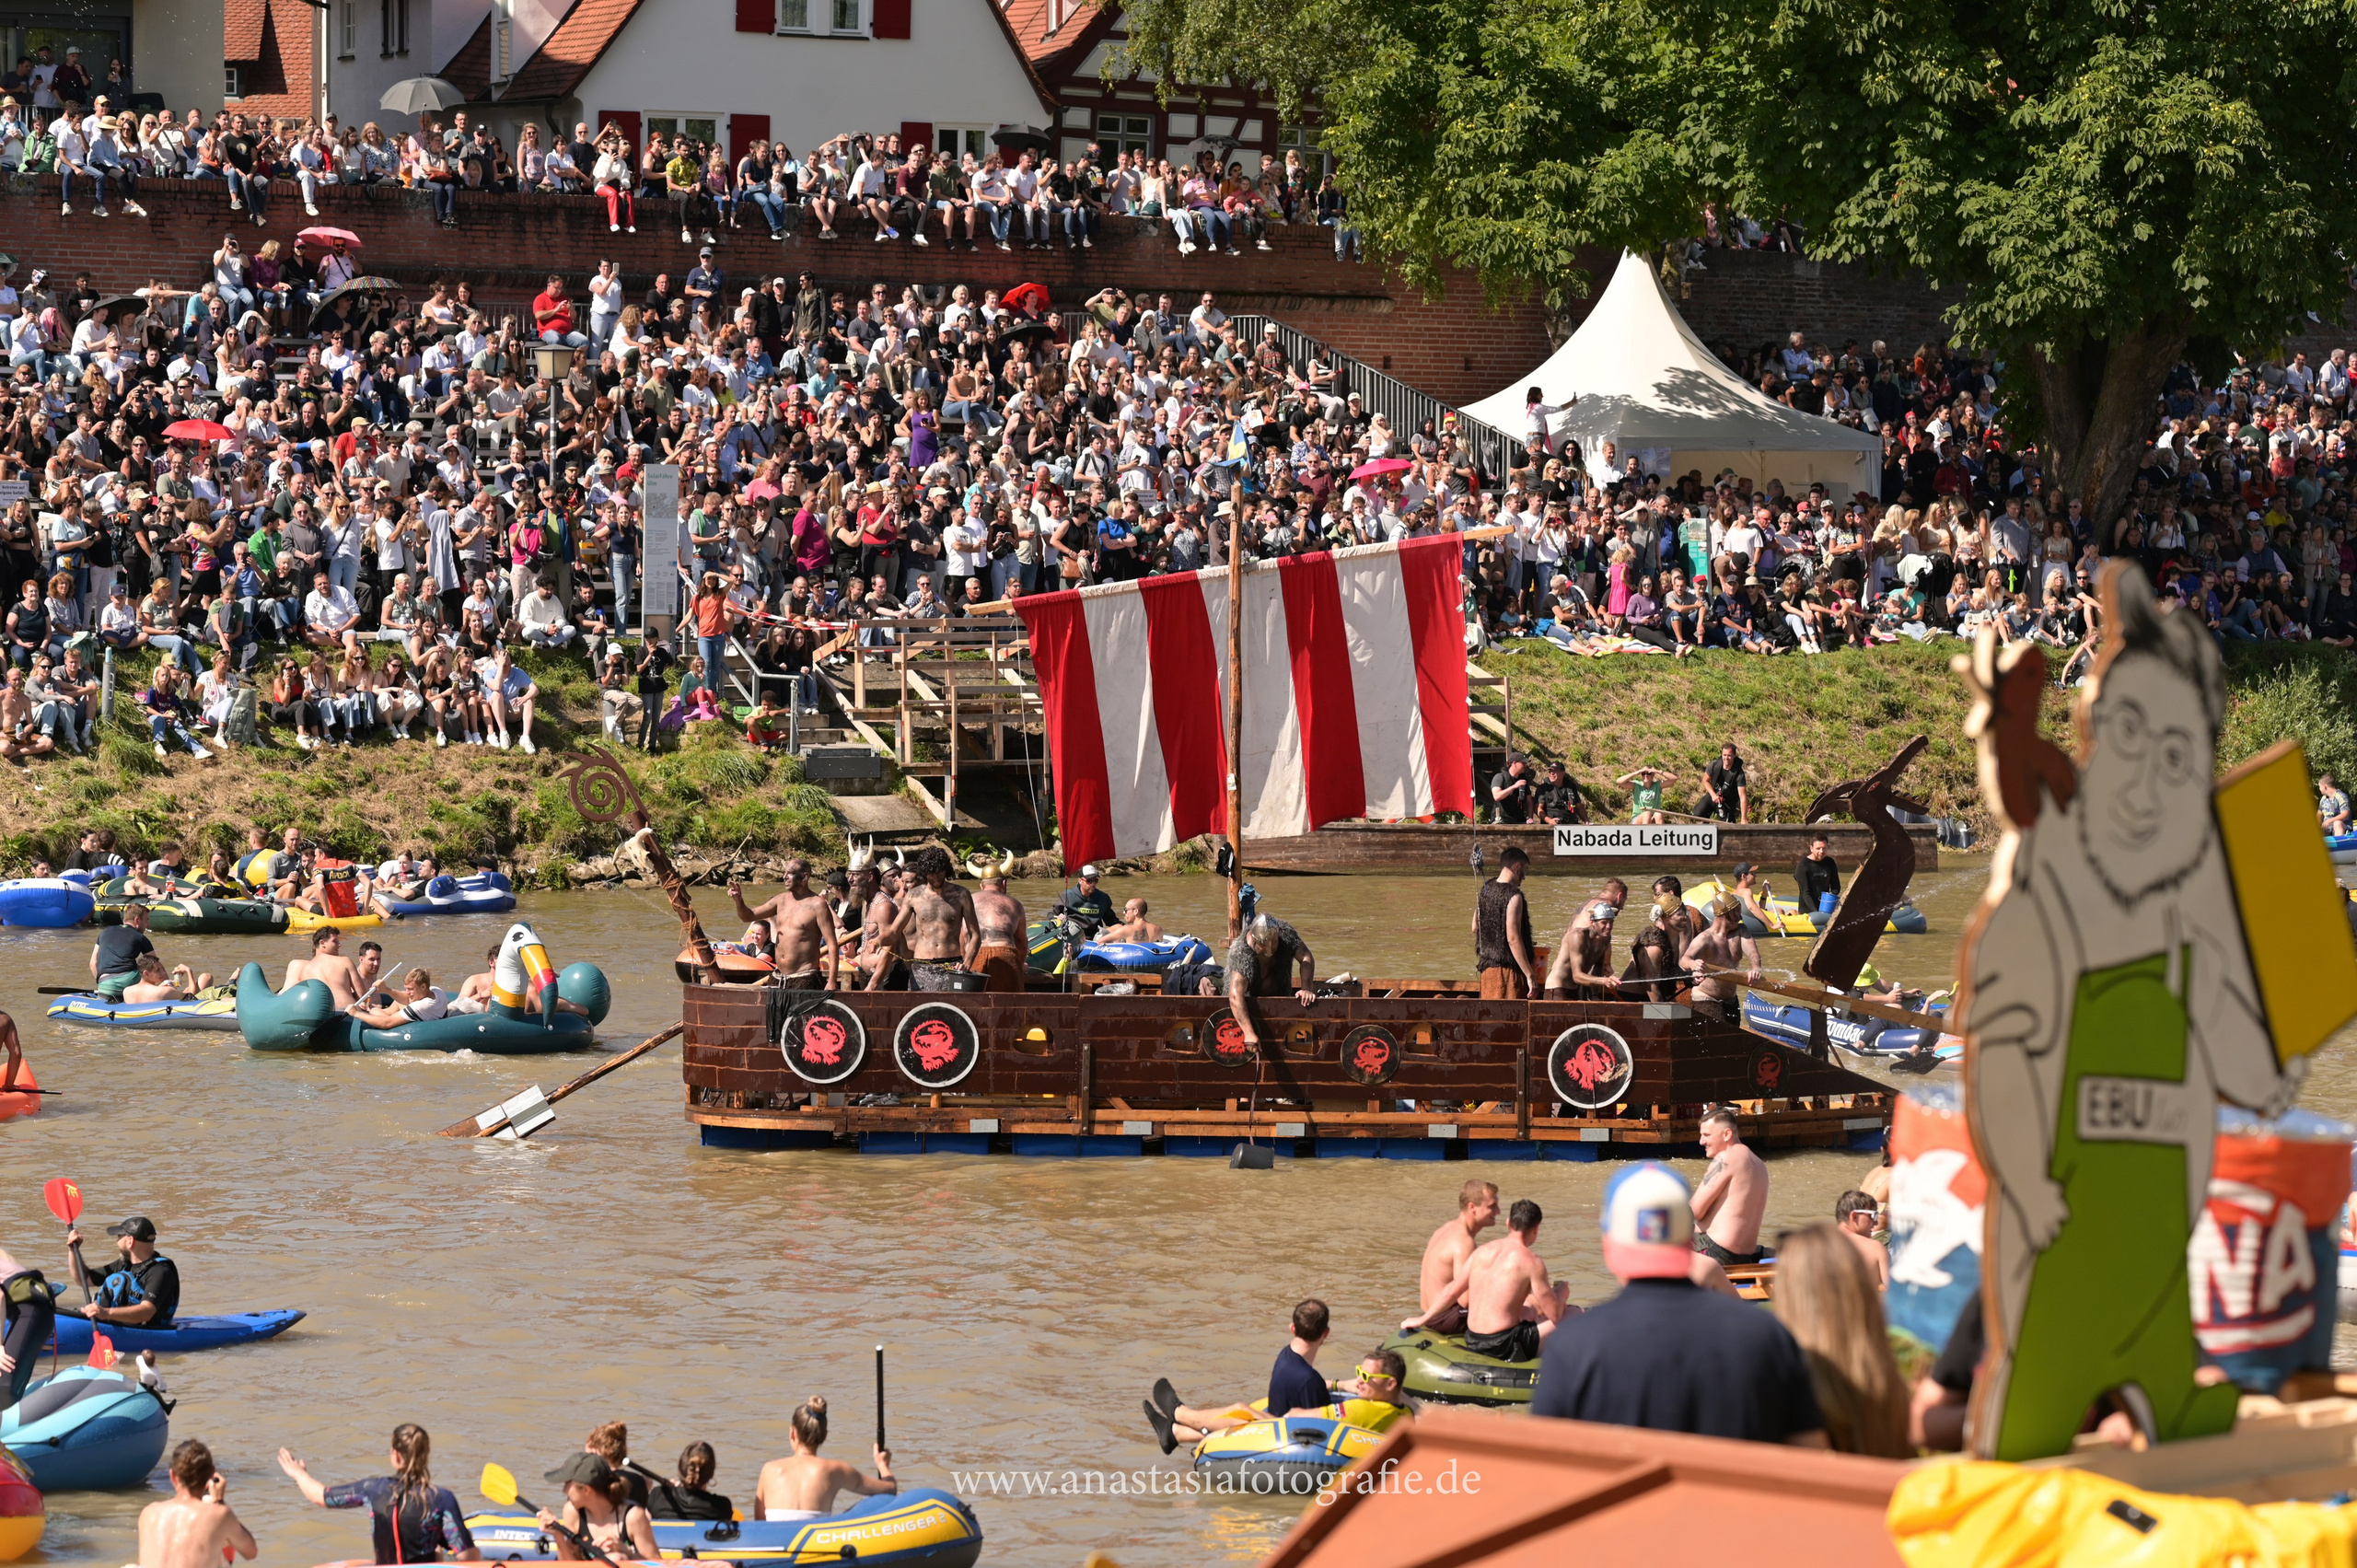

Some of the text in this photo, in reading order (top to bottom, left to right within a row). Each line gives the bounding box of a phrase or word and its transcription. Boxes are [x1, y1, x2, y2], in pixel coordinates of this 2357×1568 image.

[1558, 830, 1713, 851] Nabada Leitung
[2087, 1084, 2154, 1129] EBU
[493, 1529, 536, 1541] INTEX
[816, 1512, 947, 1544] CHALLENGER 2
